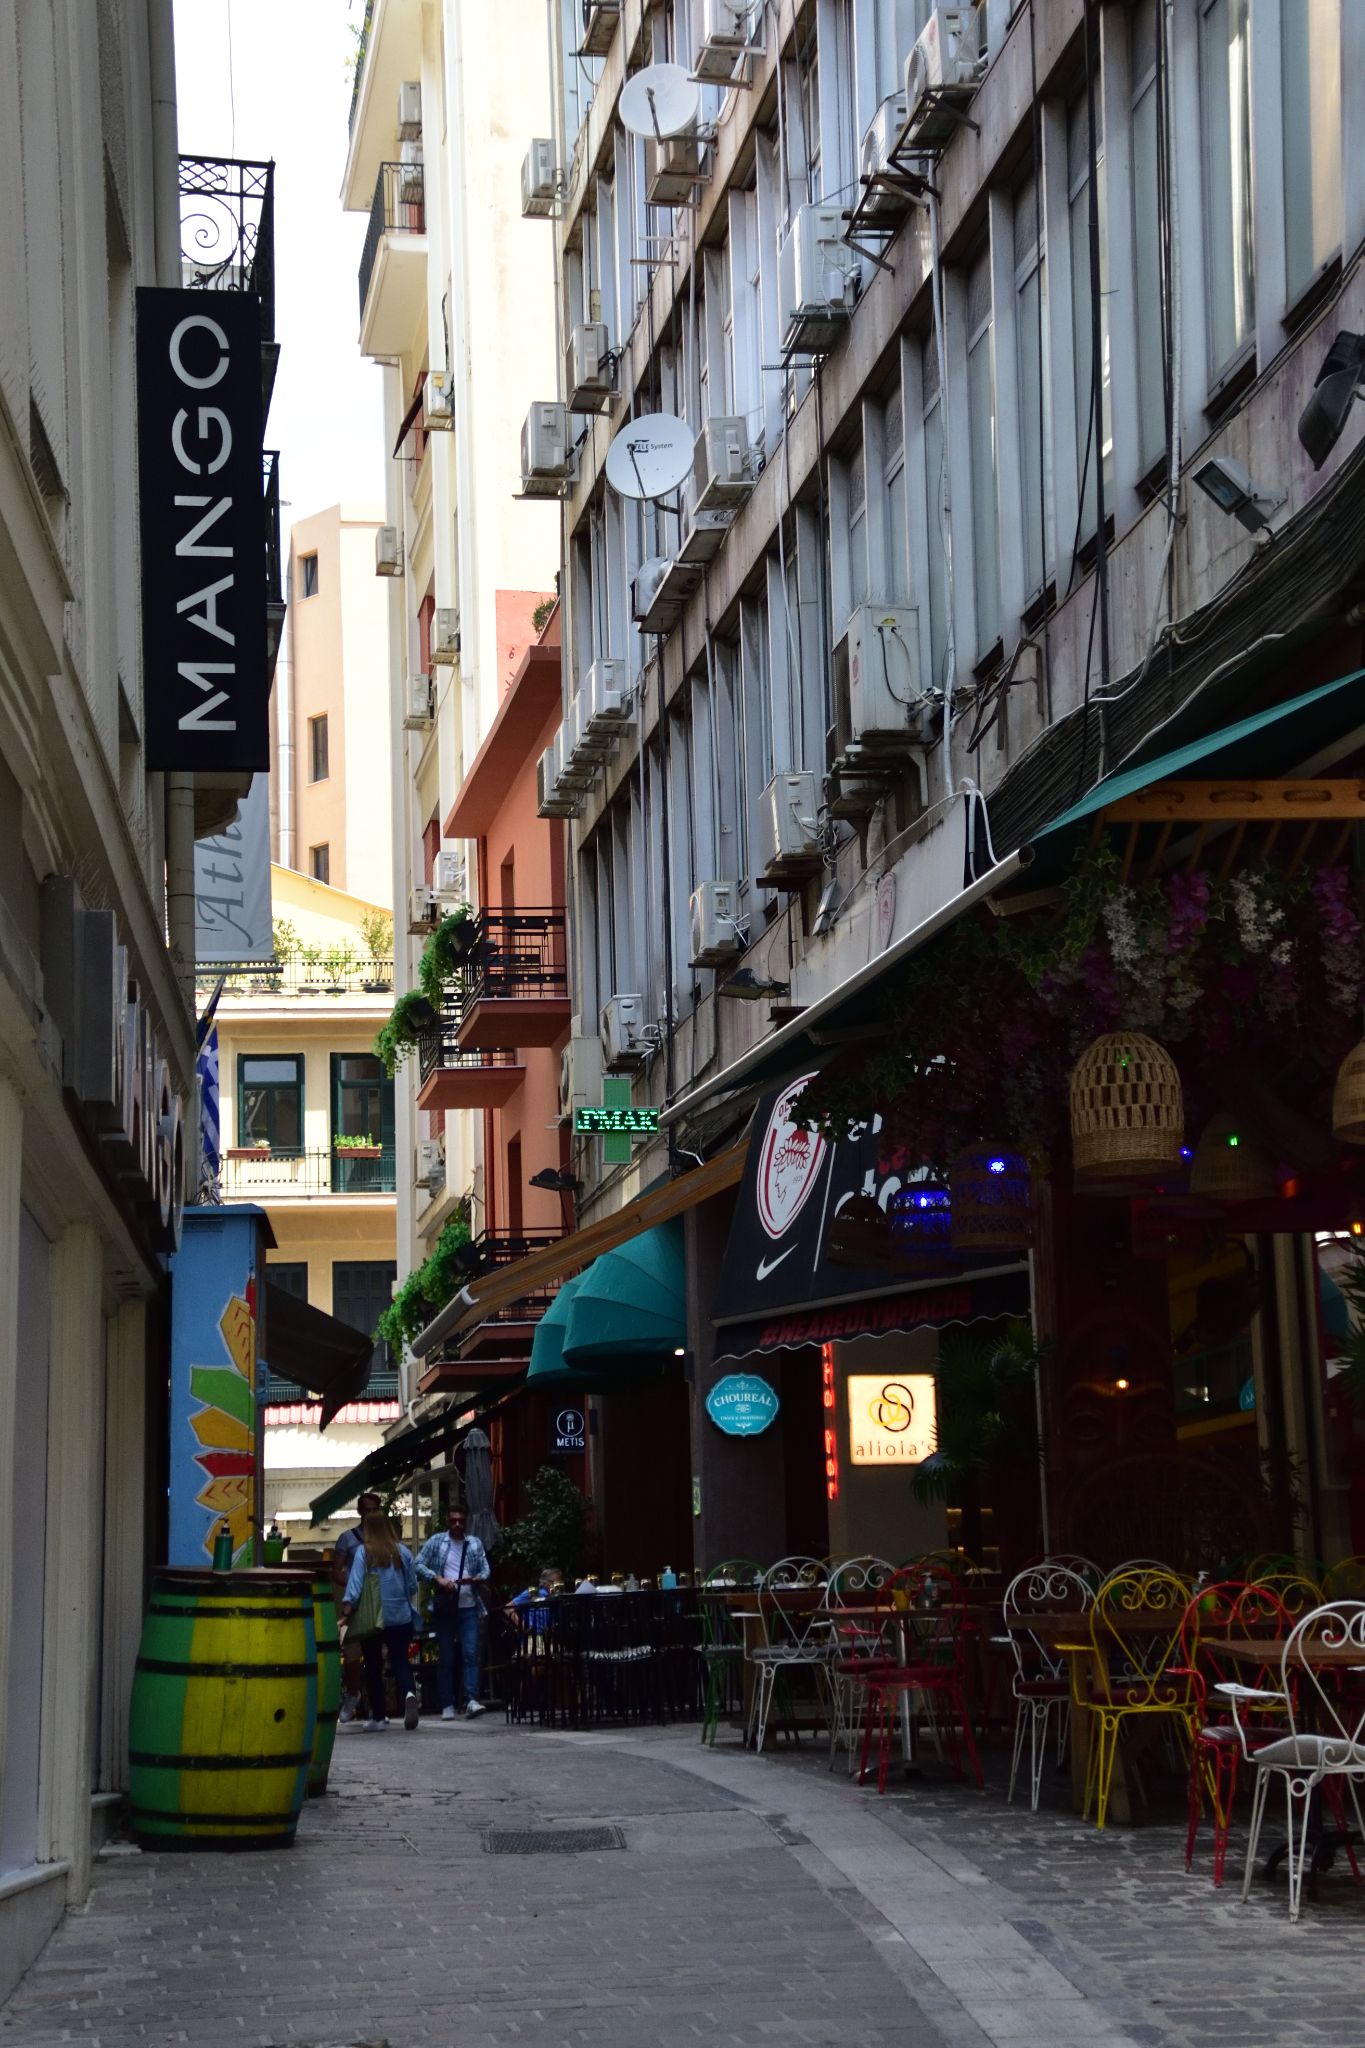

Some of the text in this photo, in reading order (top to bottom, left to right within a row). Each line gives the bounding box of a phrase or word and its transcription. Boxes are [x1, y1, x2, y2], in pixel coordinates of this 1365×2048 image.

[650, 442, 673, 451] System
[168, 314, 237, 731] MANGO
[556, 1437, 585, 1447] METIS
